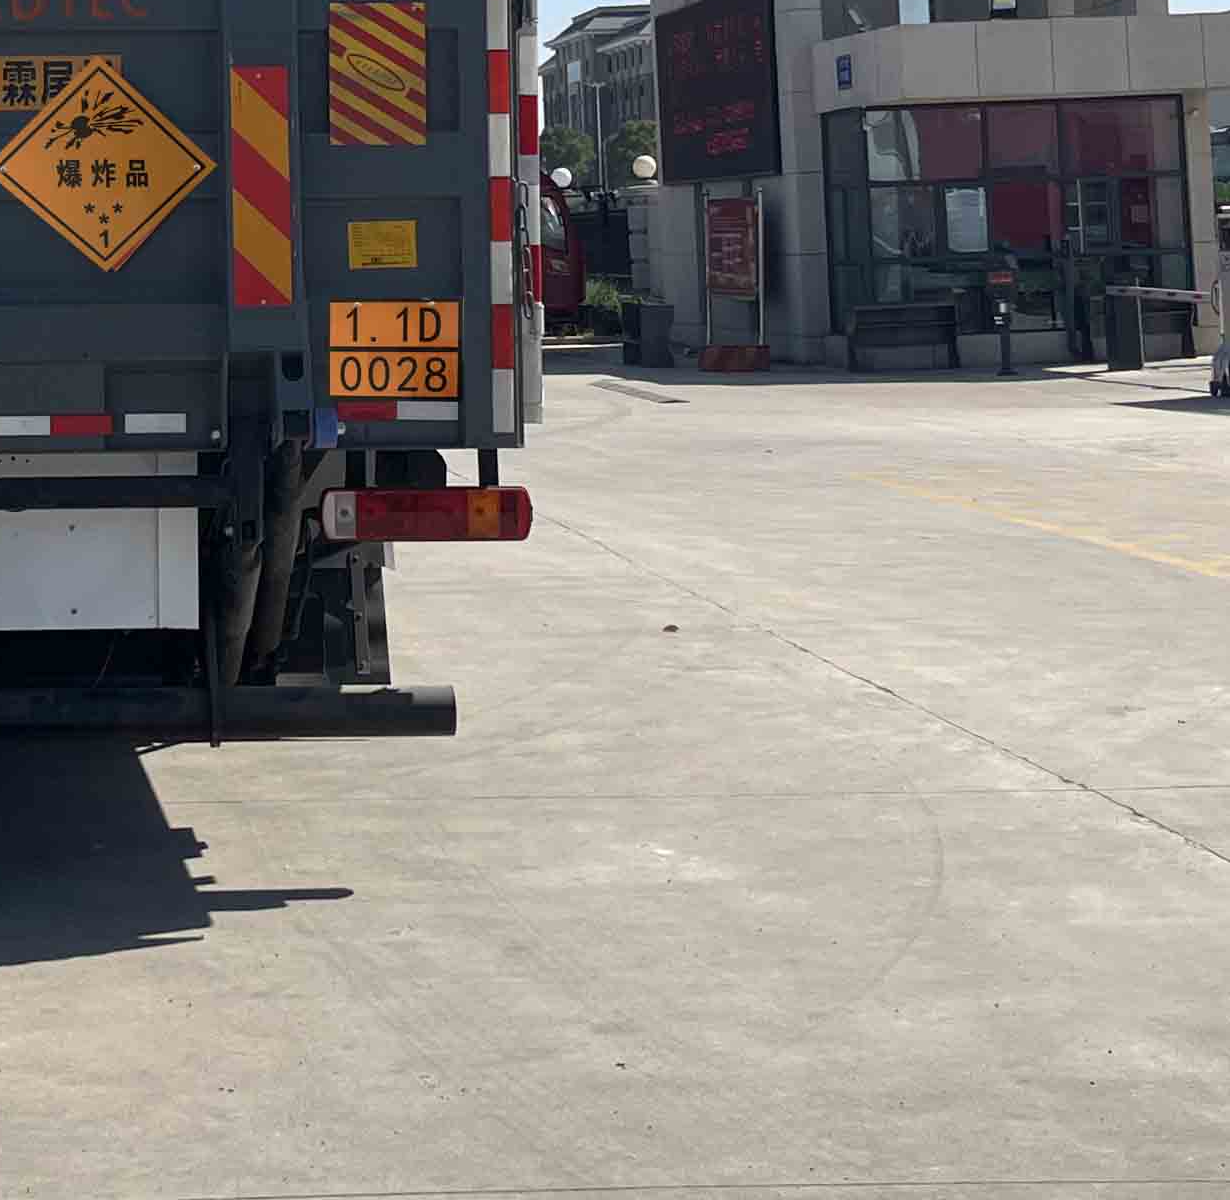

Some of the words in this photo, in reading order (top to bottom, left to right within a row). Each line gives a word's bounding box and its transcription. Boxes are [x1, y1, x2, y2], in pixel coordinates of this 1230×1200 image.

[56, 159, 150, 188] 爆炸品
[340, 356, 447, 393] 0028
